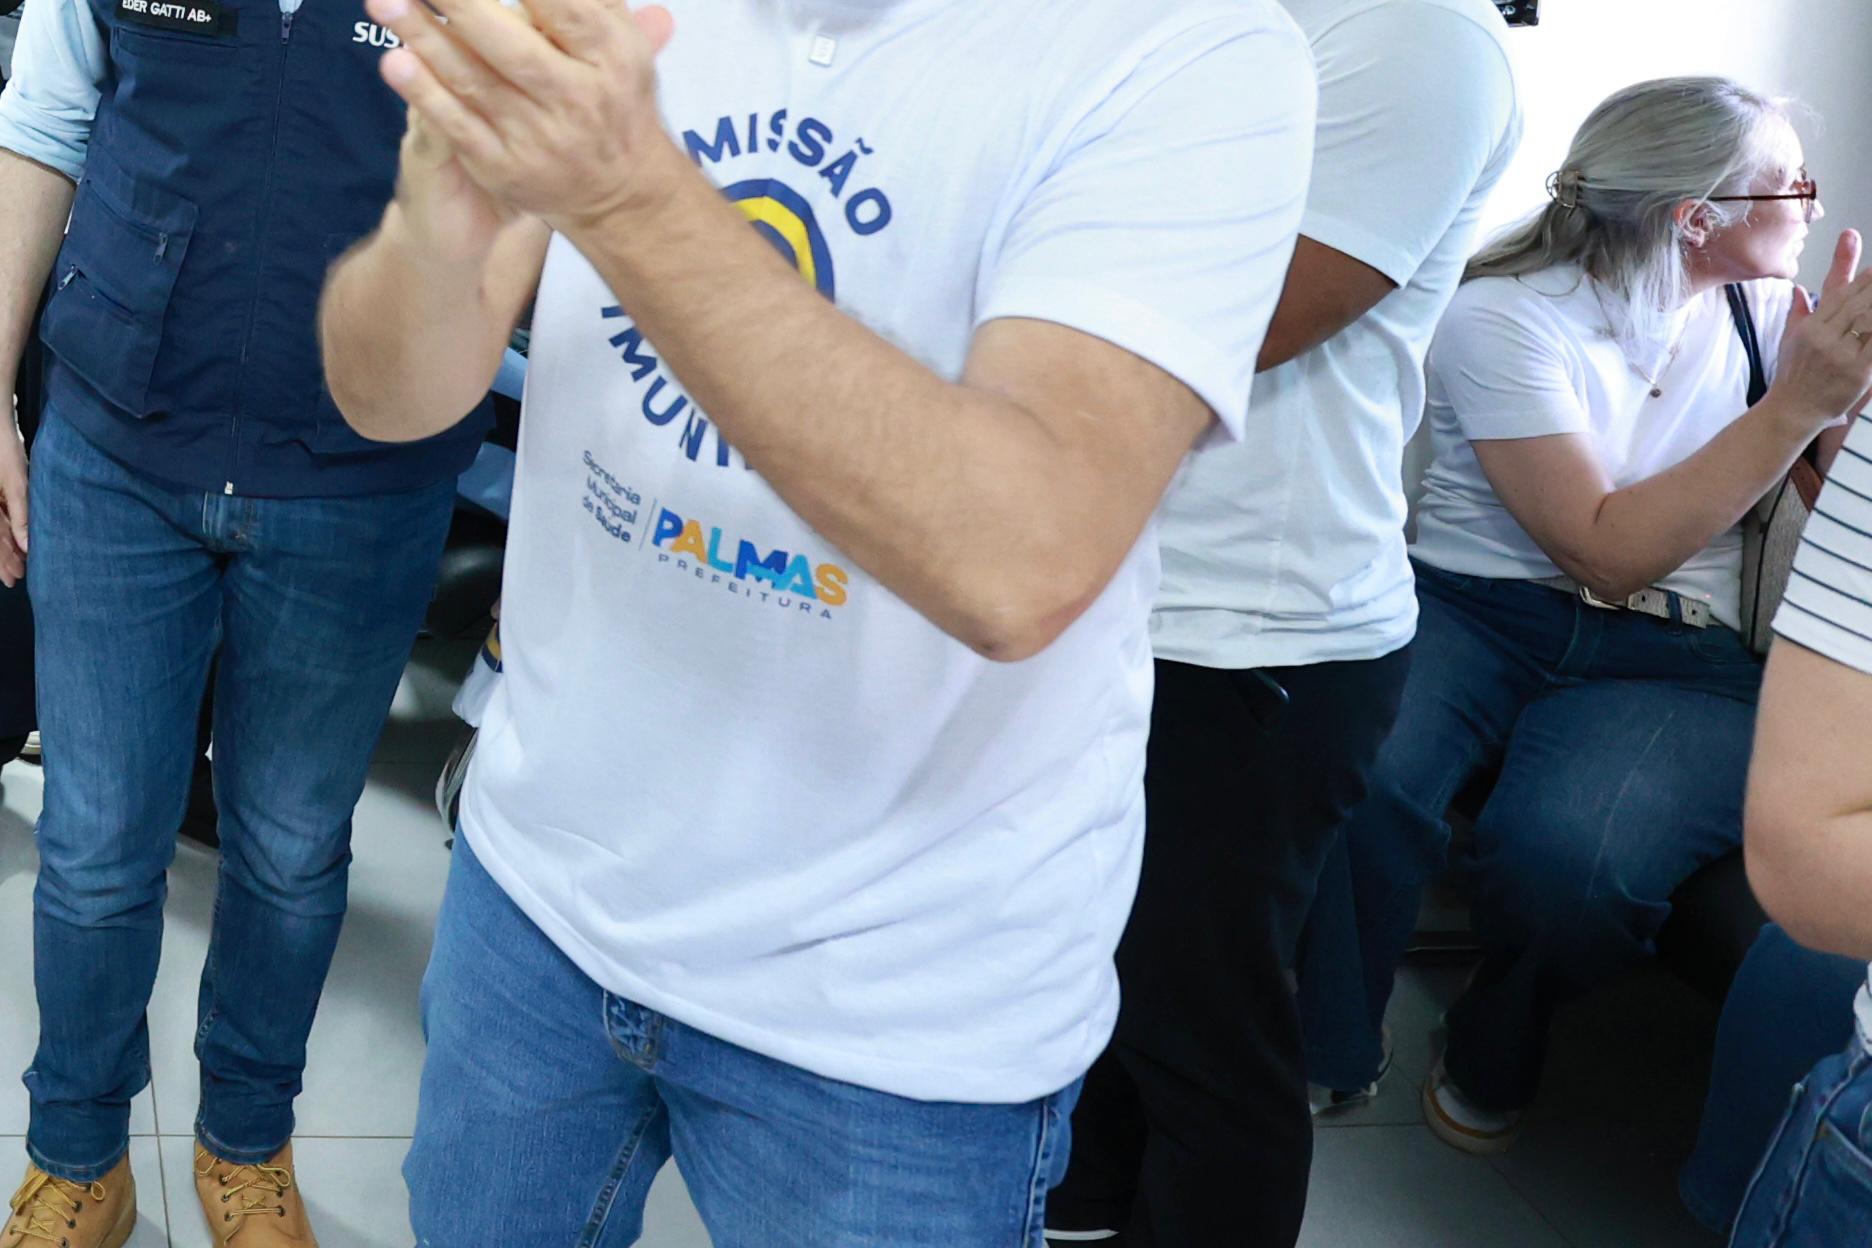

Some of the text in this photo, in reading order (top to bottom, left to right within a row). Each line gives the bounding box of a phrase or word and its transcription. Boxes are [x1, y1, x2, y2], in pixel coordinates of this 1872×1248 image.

[150, 1, 186, 19] GATTI
[187, 7, 212, 23] AB+
[352, 21, 401, 49] SUS
[682, 108, 892, 236] MISSÃO
[652, 507, 849, 607] PALMAS
[657, 553, 833, 620] PREFEITURA
